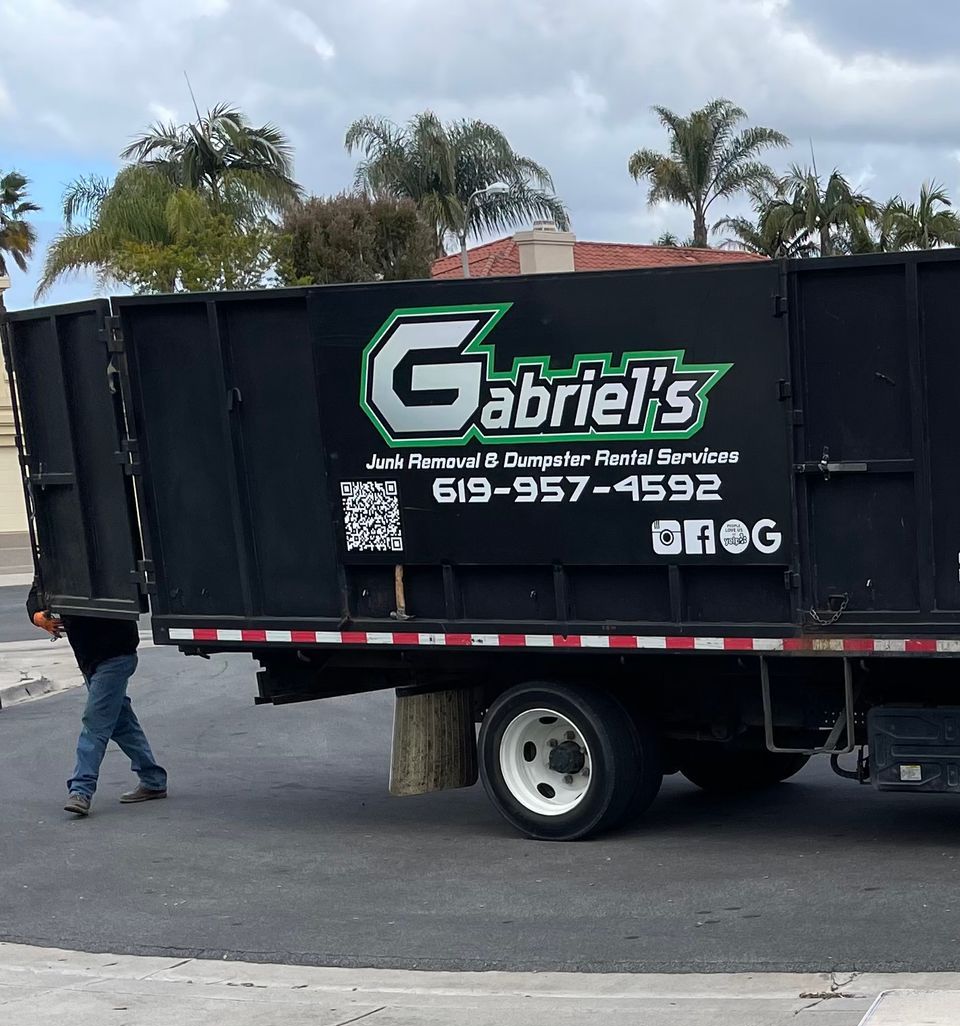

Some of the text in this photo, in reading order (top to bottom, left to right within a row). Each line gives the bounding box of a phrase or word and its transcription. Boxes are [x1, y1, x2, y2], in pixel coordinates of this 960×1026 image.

[372, 320, 698, 432] Gabriel's
[365, 446, 740, 472] Junk Removal & Dumpster Rental Services
[432, 474, 723, 503] 619-957-4592
